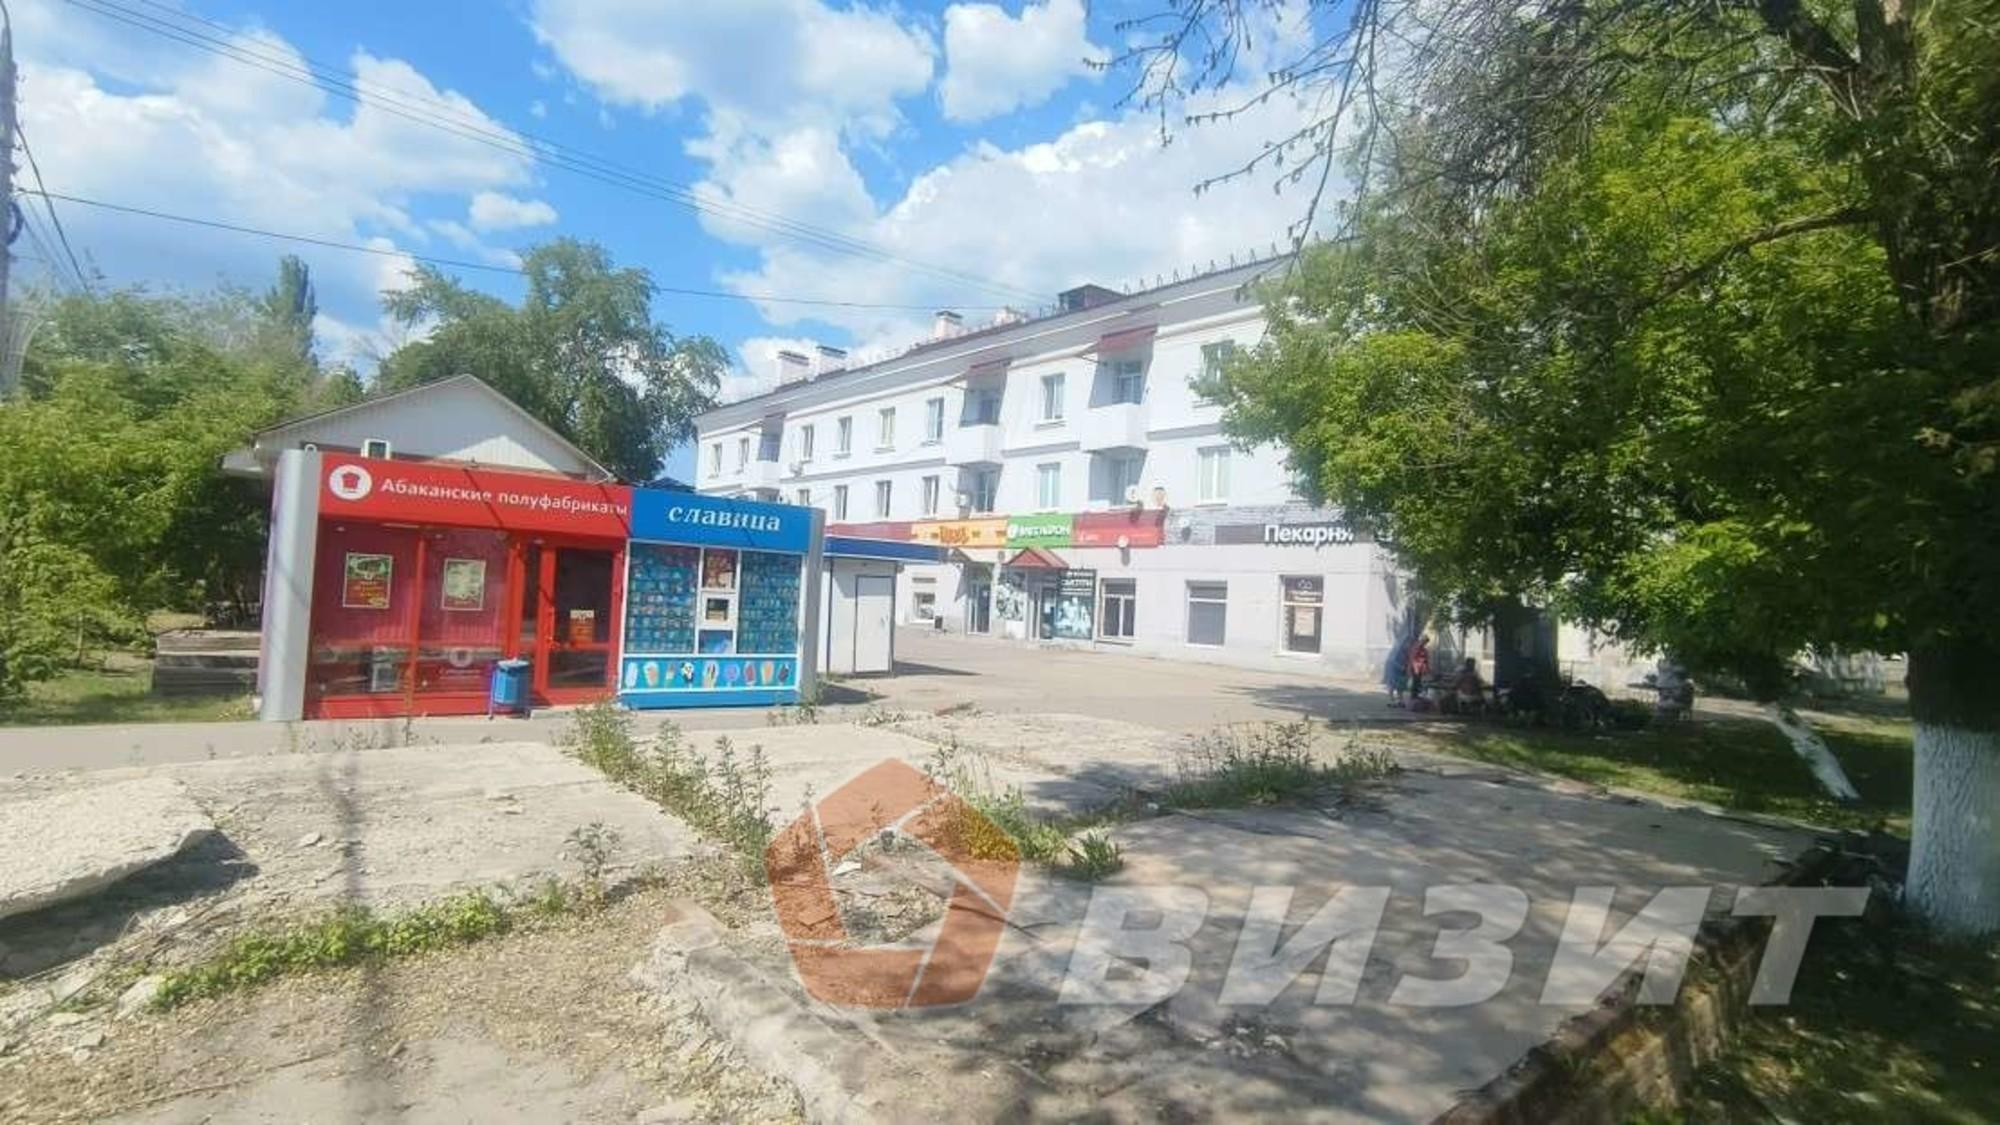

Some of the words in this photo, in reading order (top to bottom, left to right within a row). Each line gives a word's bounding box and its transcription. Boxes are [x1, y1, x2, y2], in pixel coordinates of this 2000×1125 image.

[380, 477, 493, 502] Абаканские
[498, 492, 628, 515] полуфабрикаты
[668, 506, 781, 532] славица
